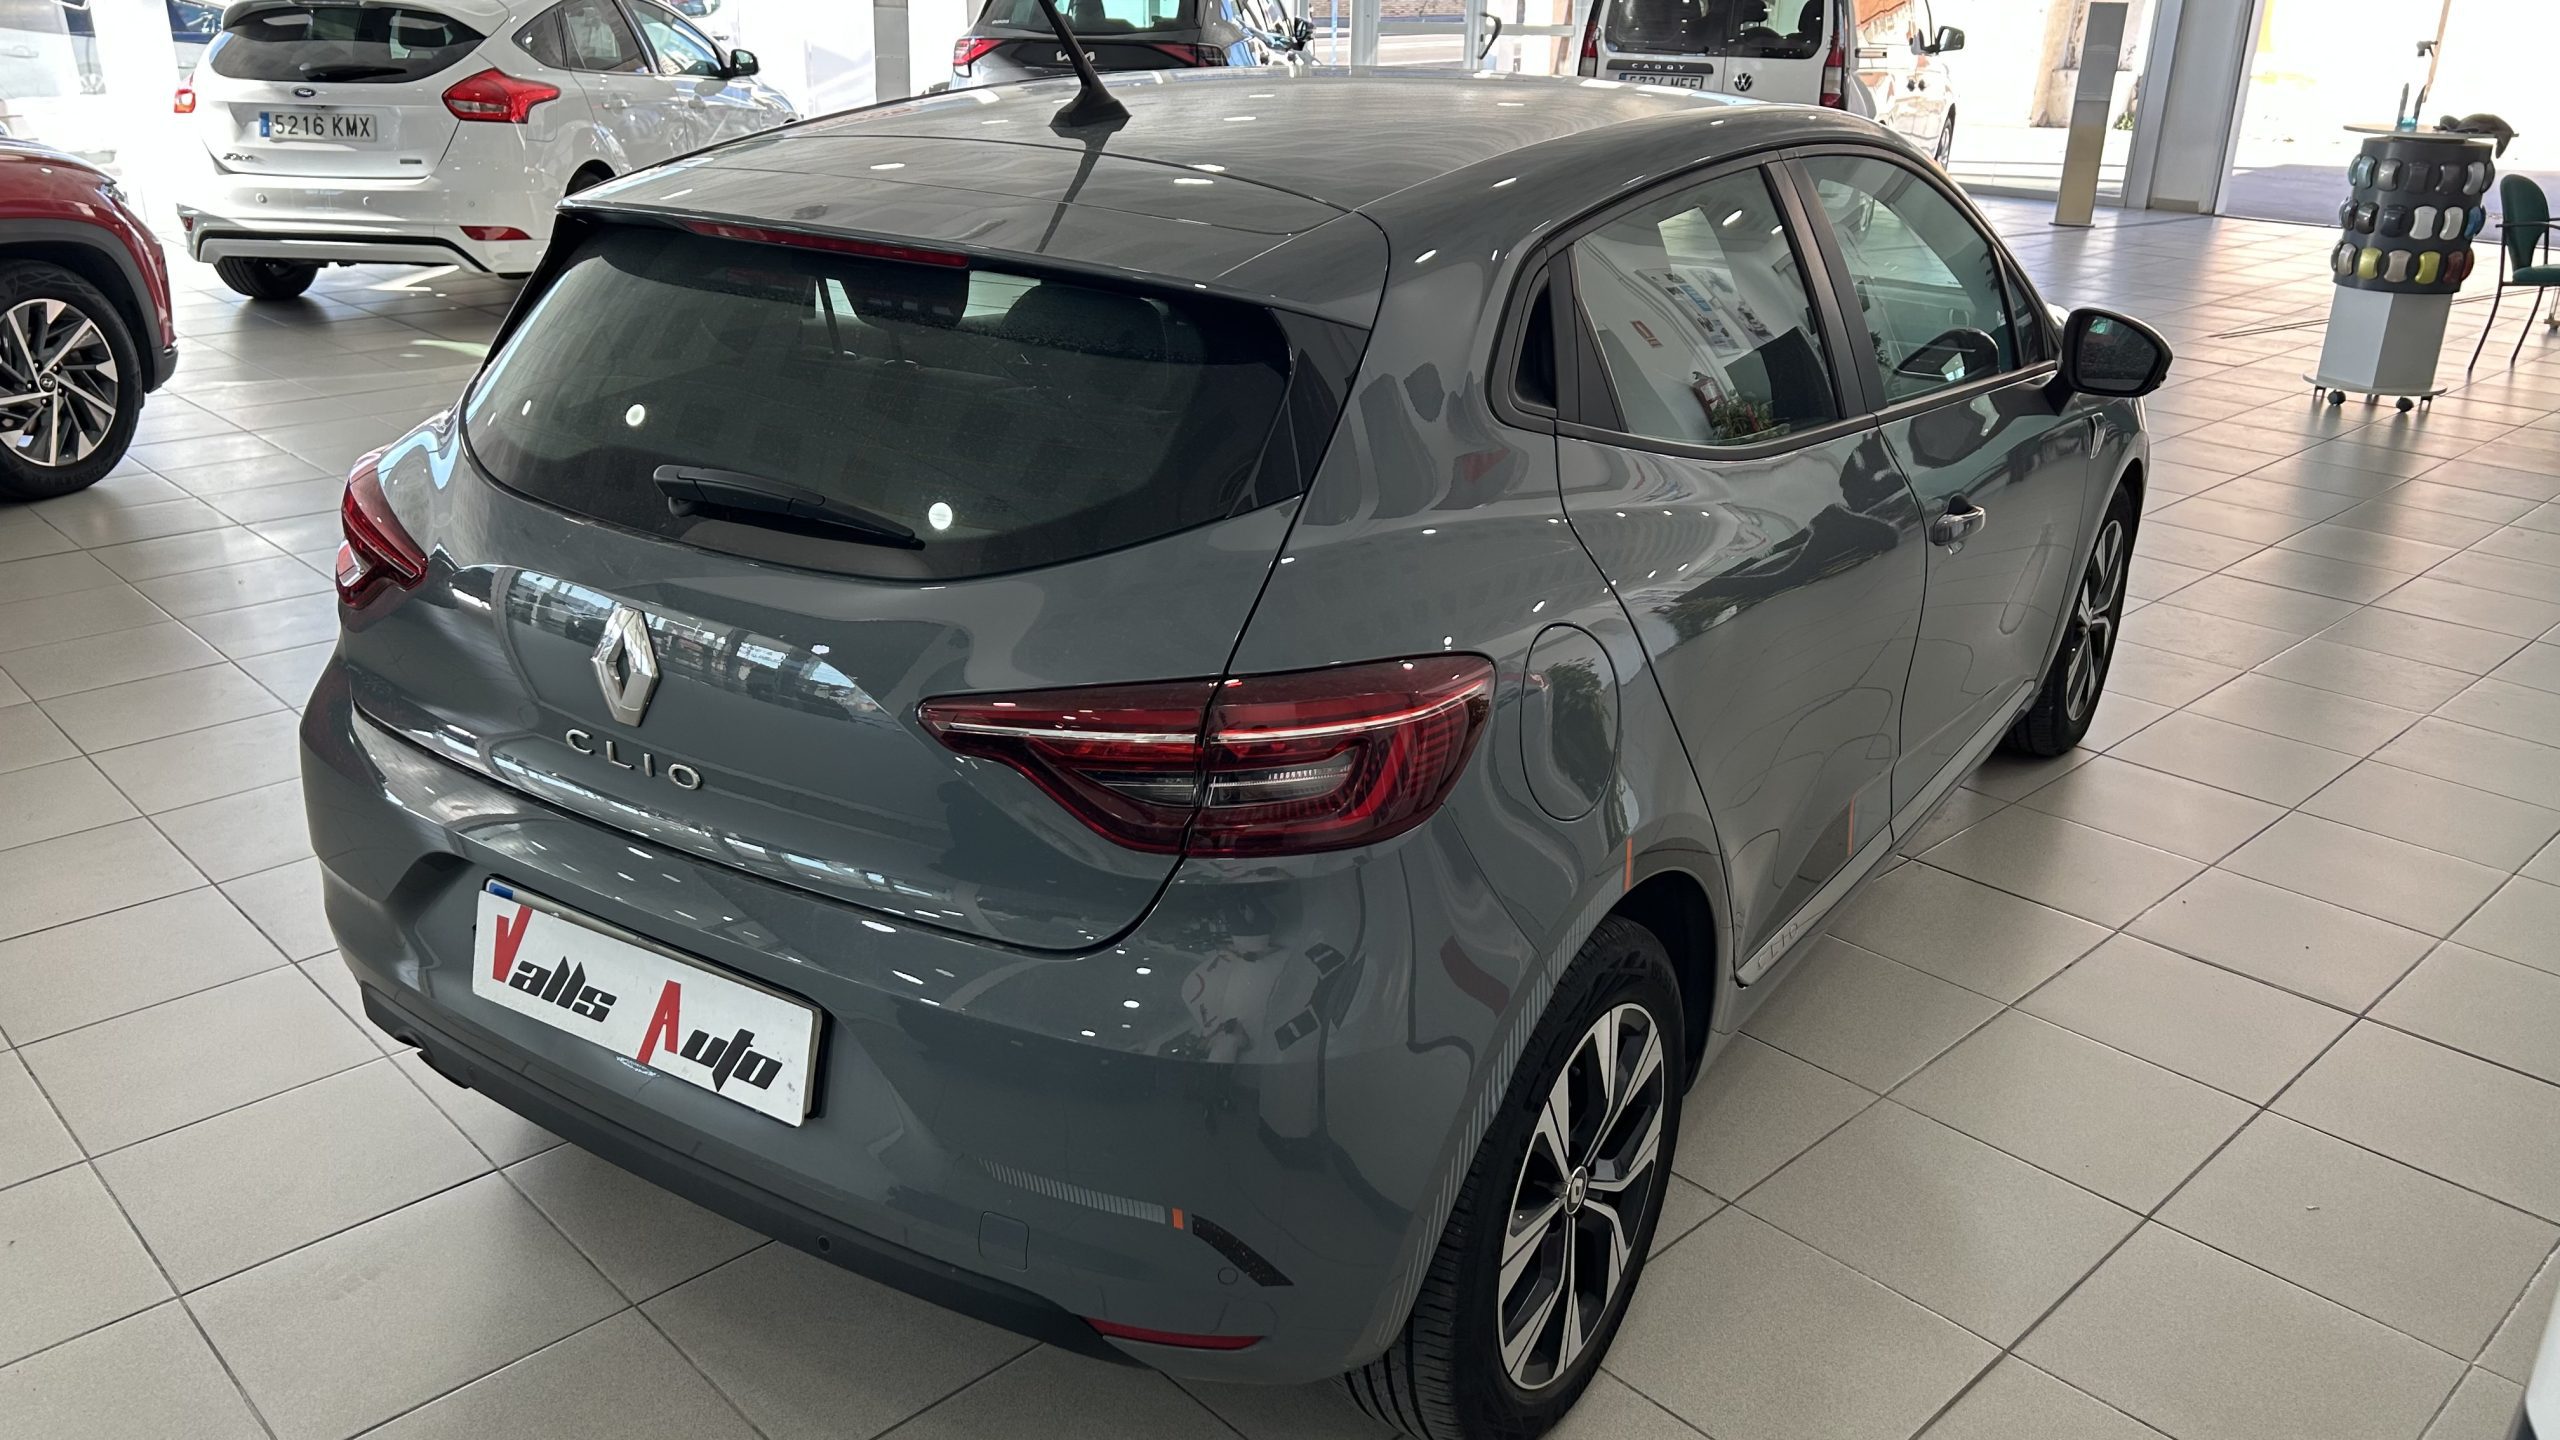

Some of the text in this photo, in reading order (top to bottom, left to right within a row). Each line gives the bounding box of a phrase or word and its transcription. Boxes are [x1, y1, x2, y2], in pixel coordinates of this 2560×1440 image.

[1632, 62, 1686, 71] CADDY
[274, 115, 371, 138] 5216 KMX
[565, 728, 702, 791] CLIO
[492, 904, 783, 1093] Valls Auto
